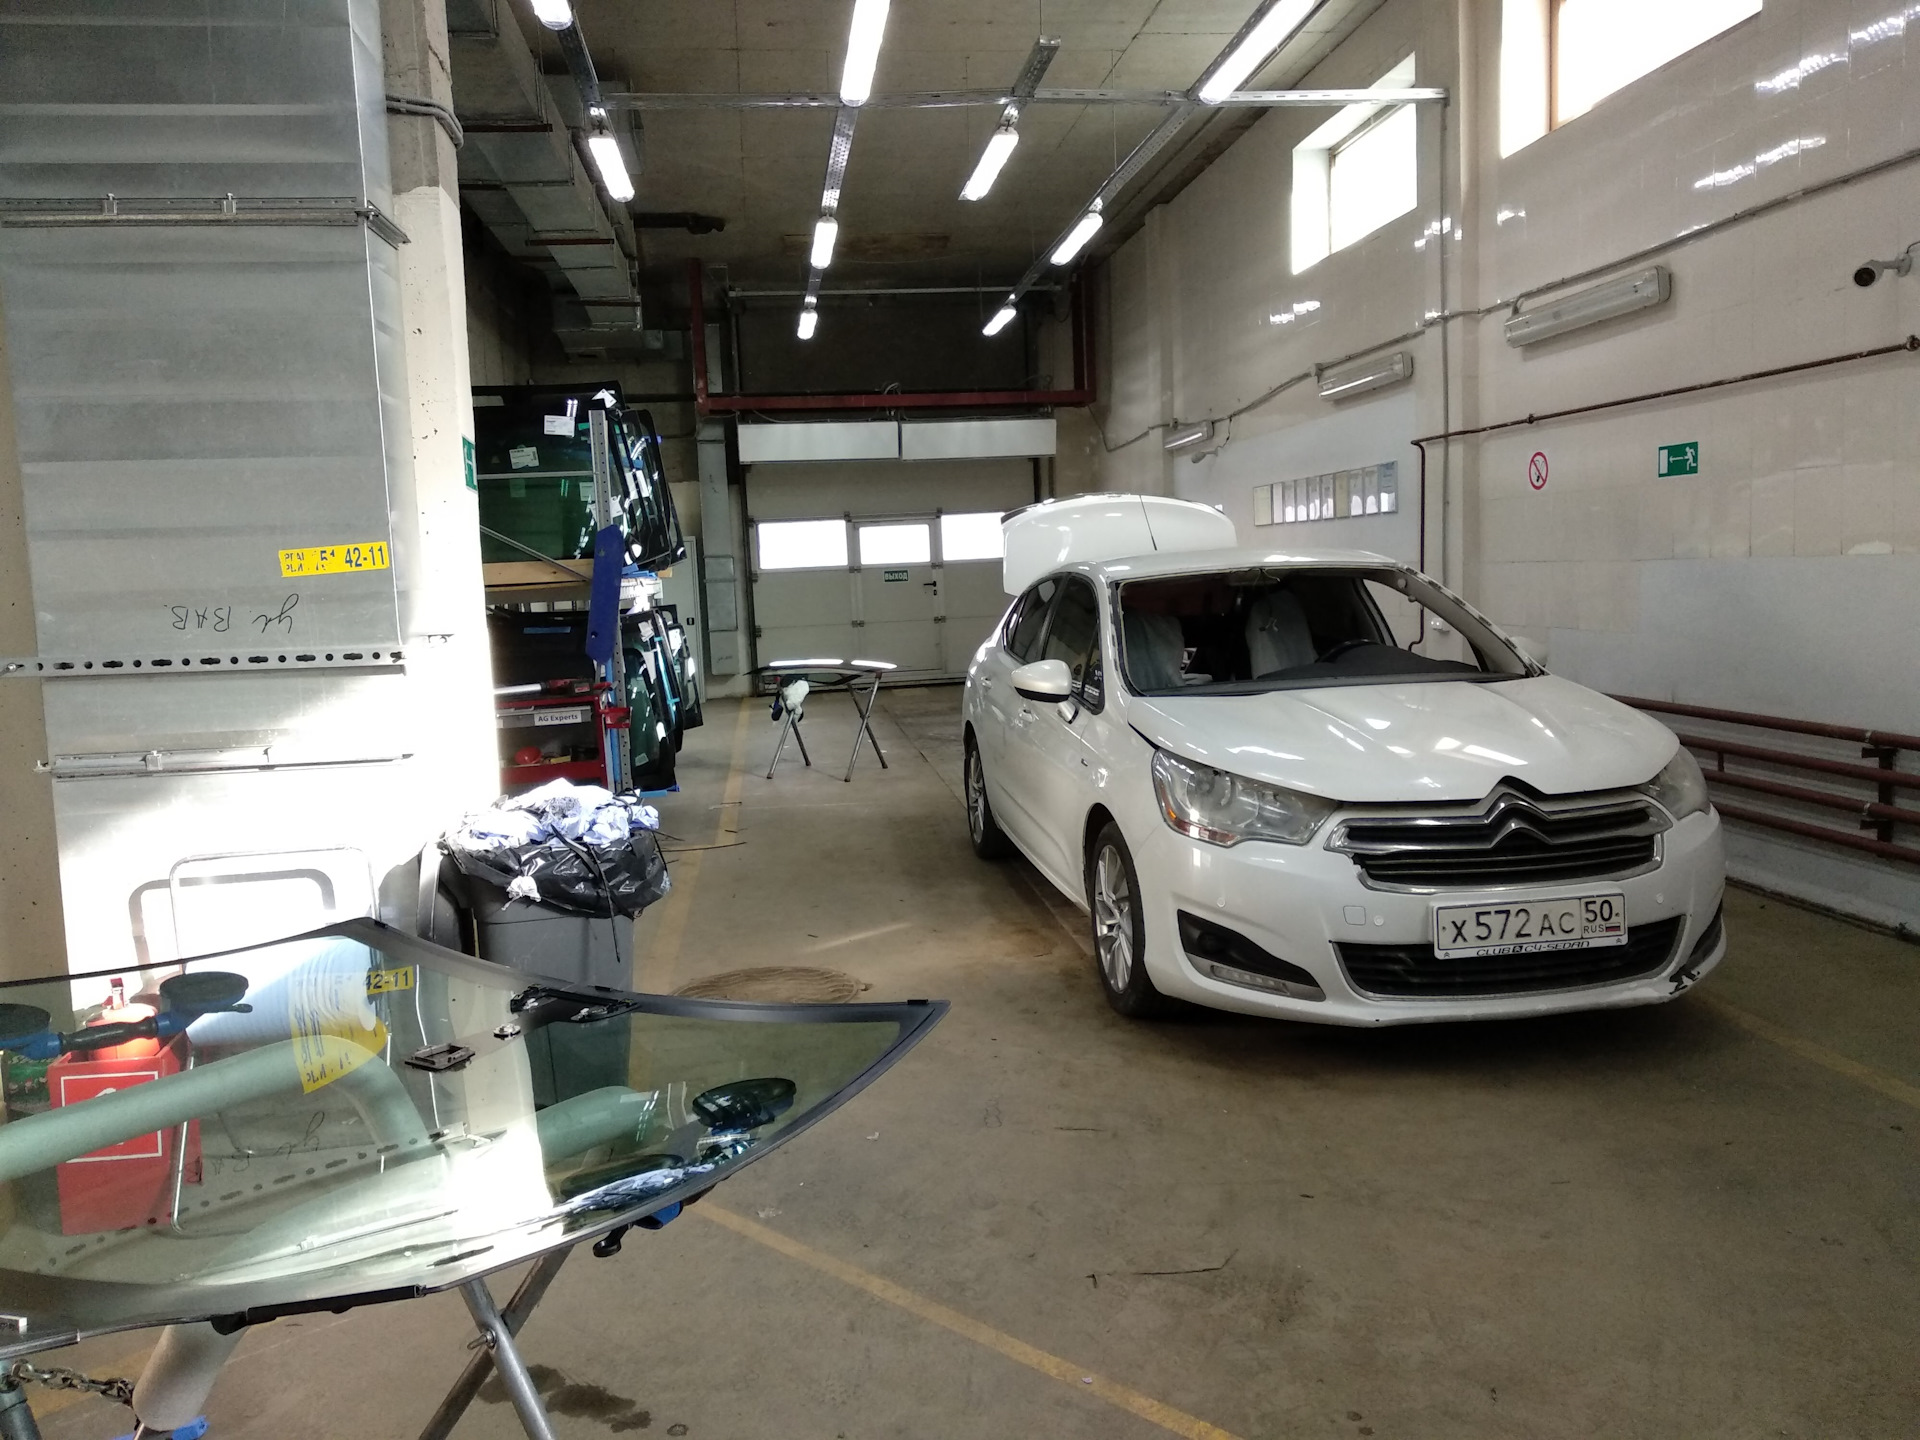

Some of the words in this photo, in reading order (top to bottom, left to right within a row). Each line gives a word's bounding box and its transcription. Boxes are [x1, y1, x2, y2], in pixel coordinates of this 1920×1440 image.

[345, 545, 385, 569] 42-11
[550, 714, 578, 722] Experts
[1584, 899, 1613, 923] 50
[1583, 923, 1604, 934] RUS
[1476, 946, 1511, 957] CLUB
